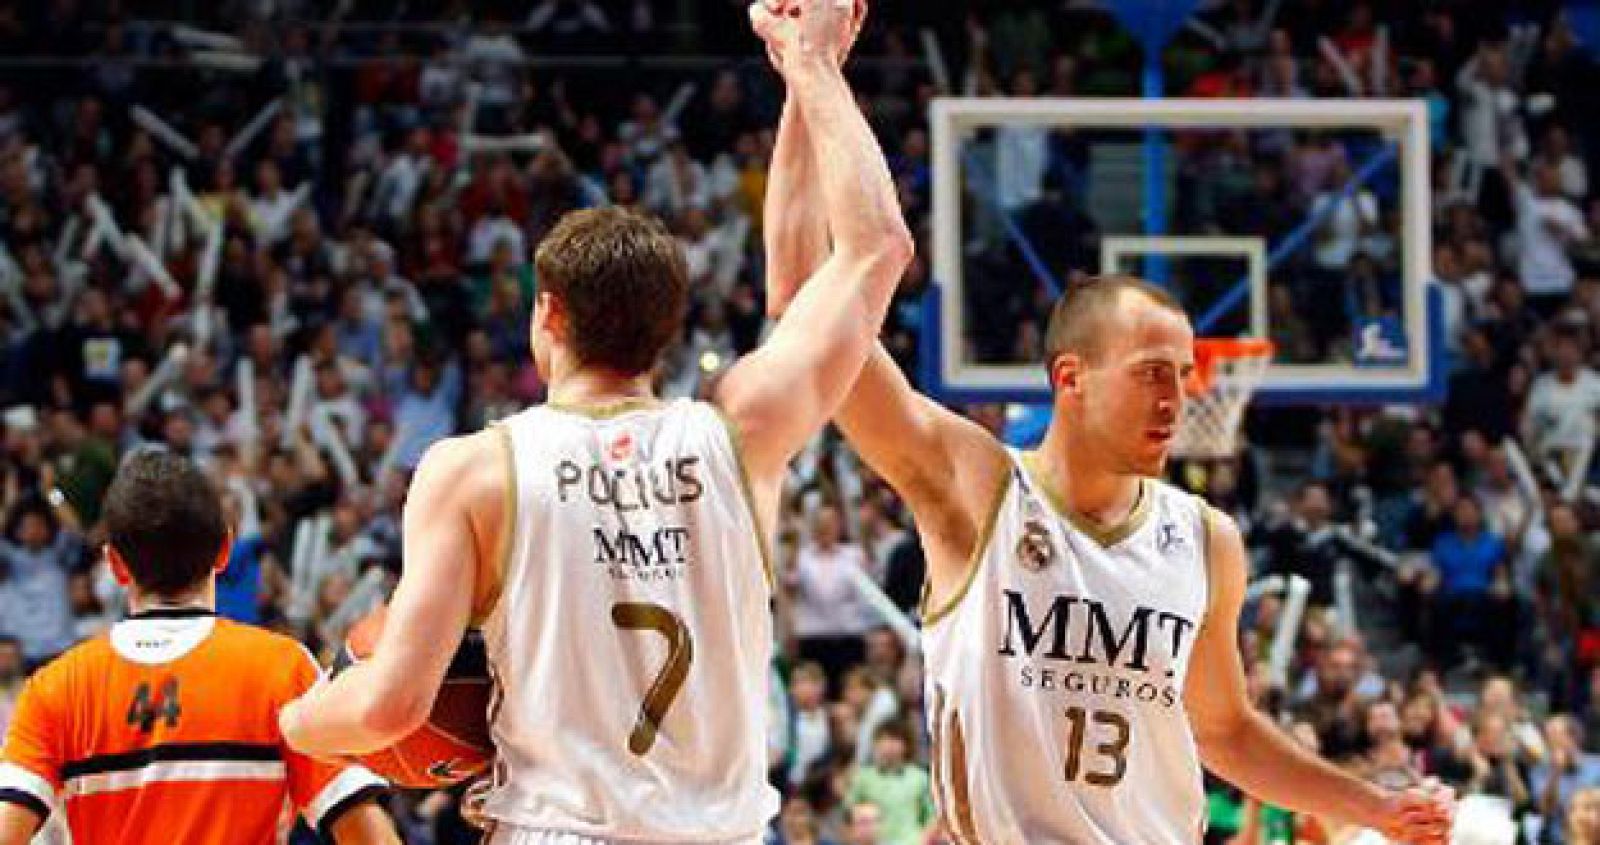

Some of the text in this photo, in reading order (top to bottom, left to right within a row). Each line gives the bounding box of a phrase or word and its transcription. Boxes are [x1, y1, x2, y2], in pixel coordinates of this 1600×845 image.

[557, 455, 705, 511] POCIUS
[998, 588, 1195, 677] MMT
[127, 676, 183, 733] 44
[611, 602, 693, 756] 7
[1019, 665, 1177, 708] SEGUROS
[1063, 706, 1131, 787] 13
